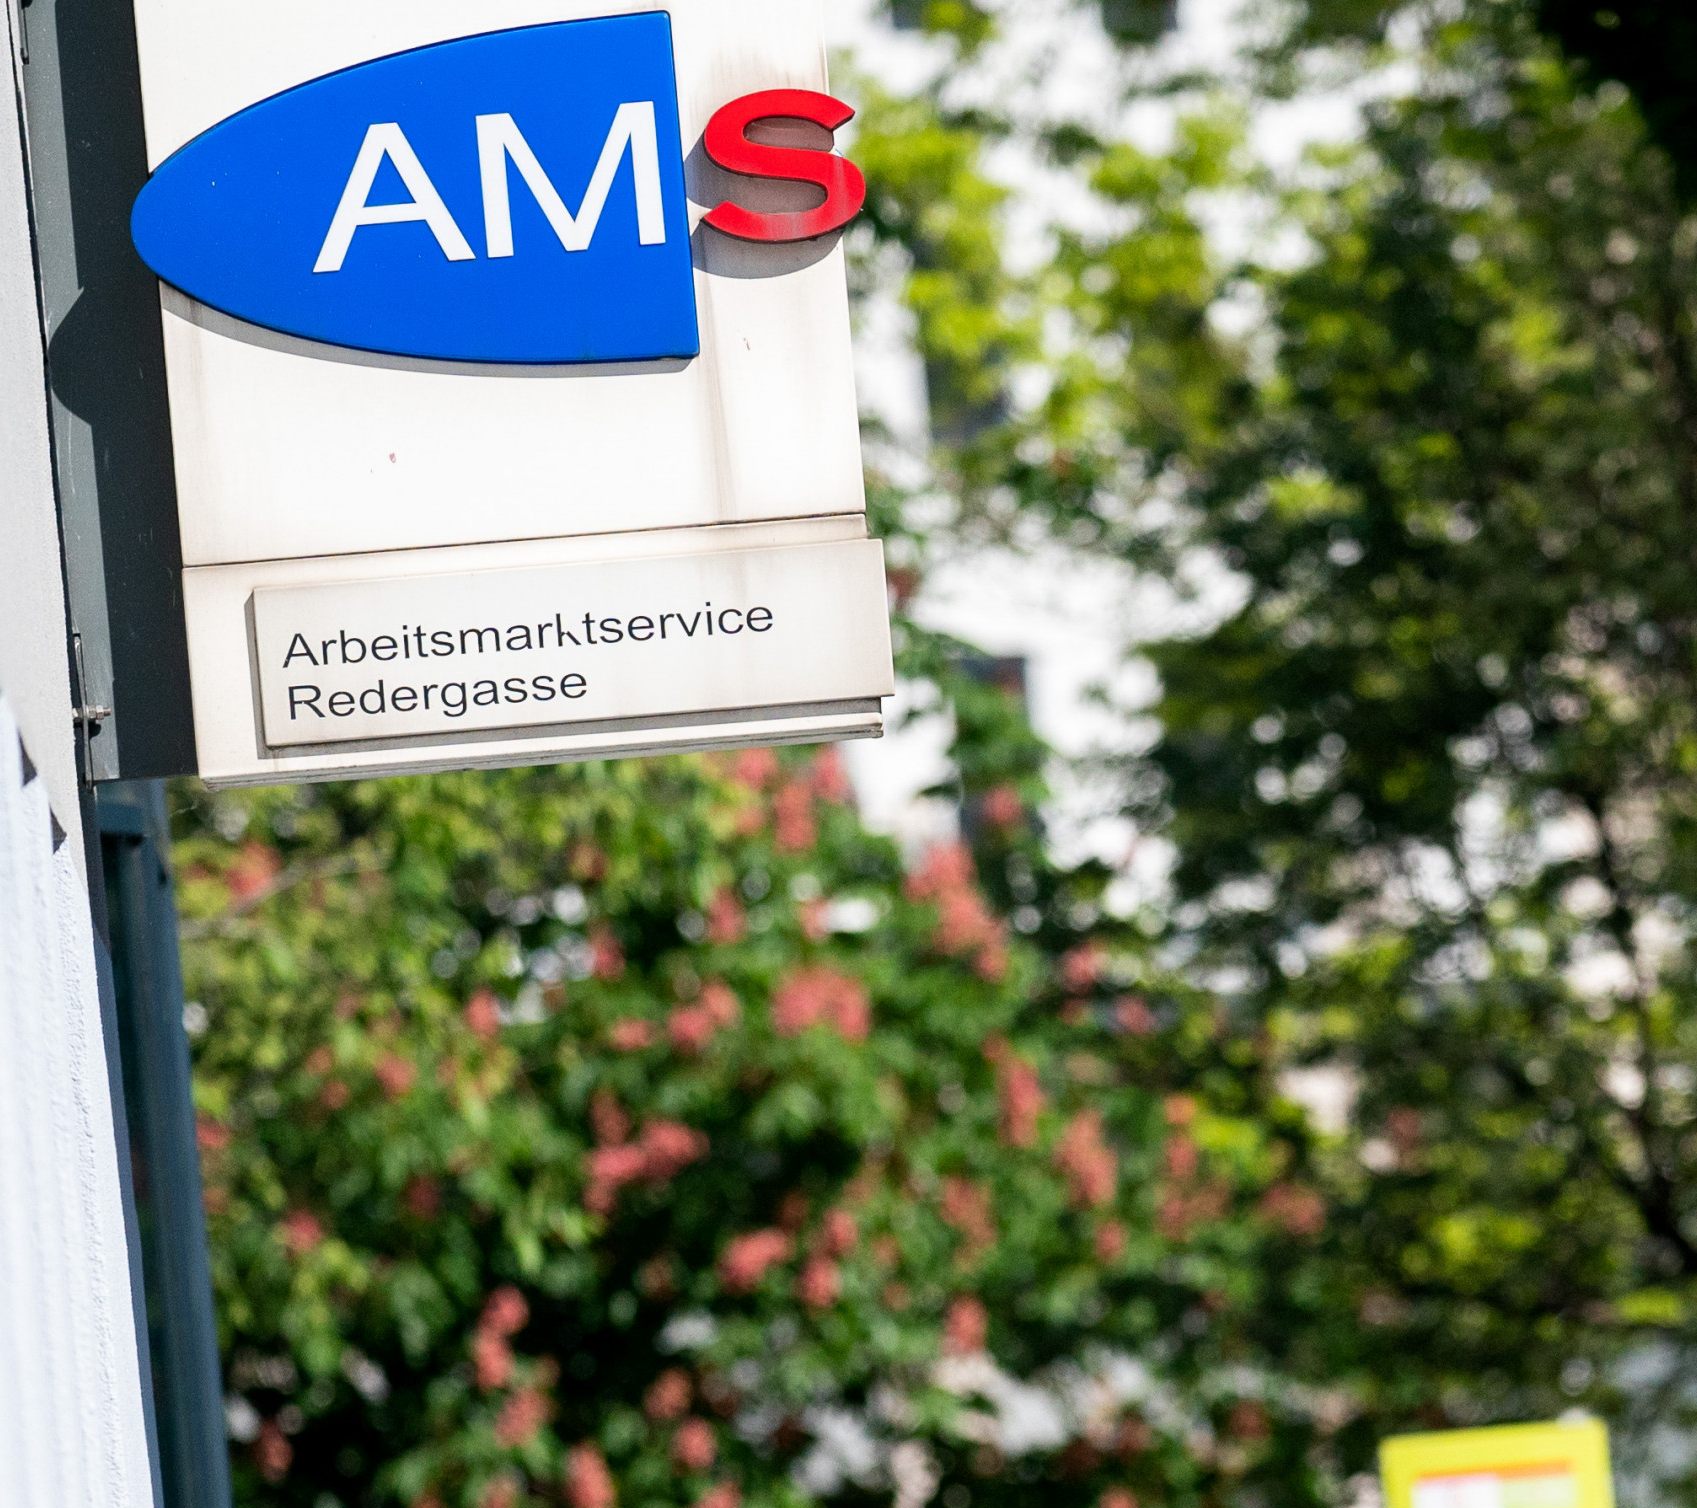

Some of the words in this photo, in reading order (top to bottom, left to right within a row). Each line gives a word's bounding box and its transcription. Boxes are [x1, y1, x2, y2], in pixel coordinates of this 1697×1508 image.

[313, 88, 866, 273] AMS
[282, 601, 773, 669] Arbeitsmarktservice
[288, 672, 588, 720] Redergasse
